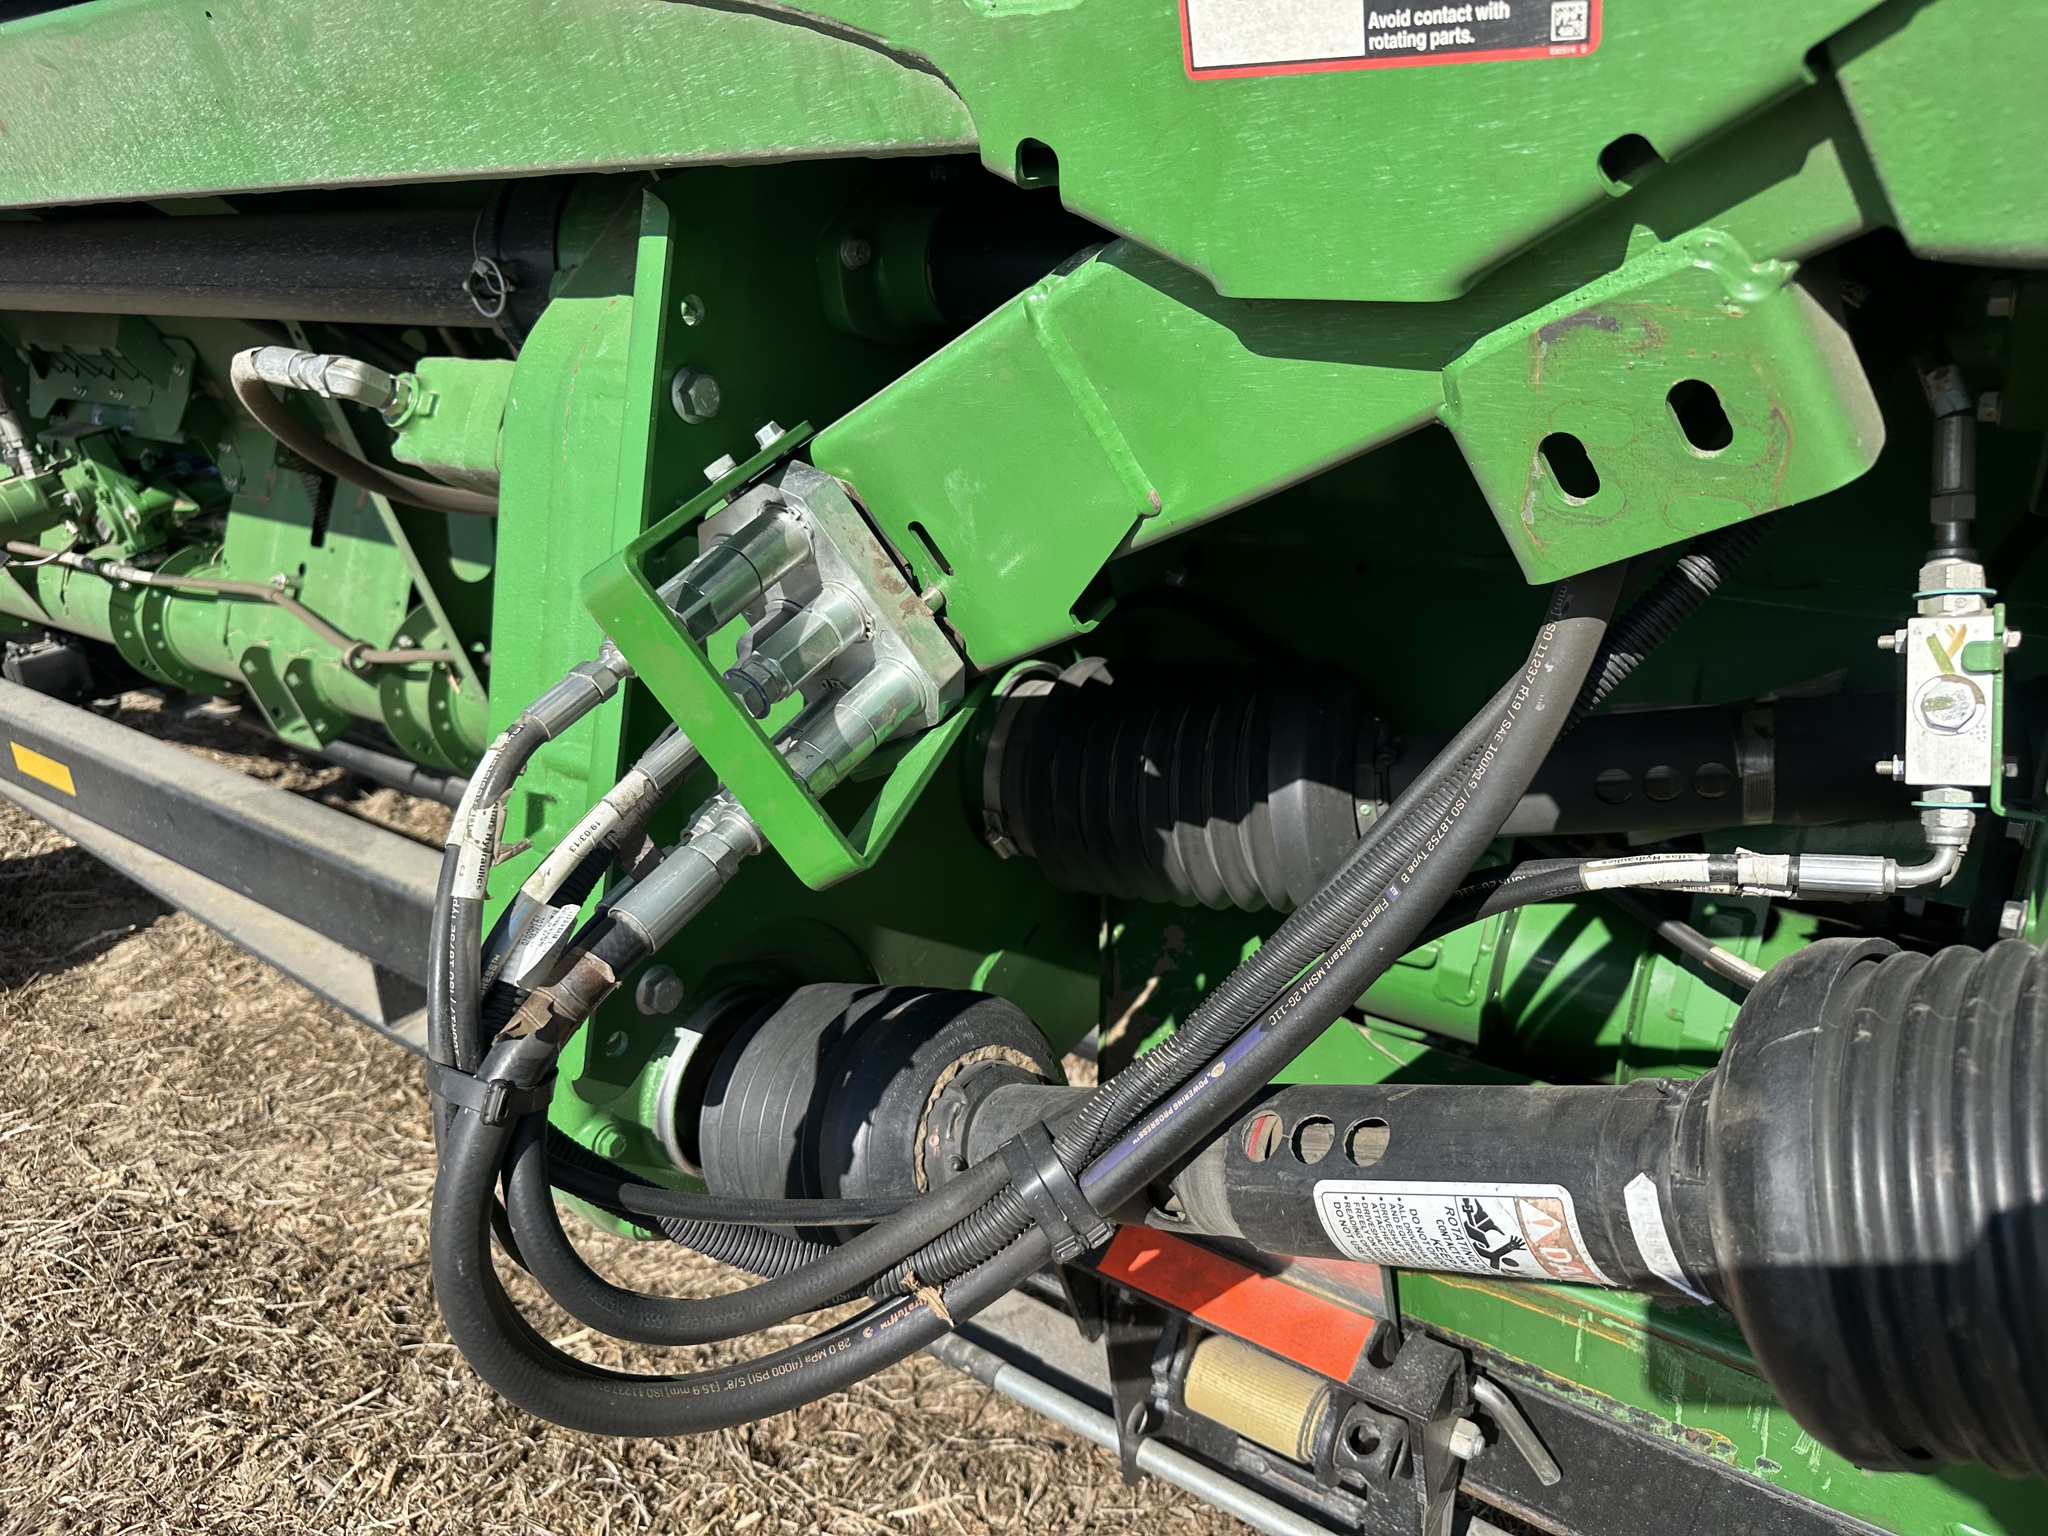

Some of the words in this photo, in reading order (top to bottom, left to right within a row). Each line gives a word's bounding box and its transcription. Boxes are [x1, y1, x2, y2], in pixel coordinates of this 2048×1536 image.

[1368, 8, 1411, 29] Avoid
[1413, 4, 1473, 26] contact
[1475, 1, 1511, 20] with
[1368, 30, 1427, 51] rotating
[1429, 26, 1476, 50] parts.
[1525, 643, 1548, 685] 11237
[1511, 684, 1530, 711] R19
[1507, 709, 1516, 720] /
[1494, 719, 1512, 744] SAE
[1468, 743, 1499, 790] 100R19
[1451, 796, 1468, 817] ISO
[1463, 788, 1471, 799] /
[568, 820, 601, 853] 19/03/13
[1425, 815, 1454, 852] 18752
[475, 832, 495, 891] Hydraulics
[1407, 850, 1430, 874] Type
[1601, 855, 1662, 865] Hydraulics
[1400, 872, 1411, 884] B
[450, 896, 460, 919] Typ
[1361, 898, 1390, 928] Flame
[1324, 926, 1365, 970] Resistant
[1299, 966, 1327, 994] MSHA
[1268, 990, 1302, 1026] 2G-11C
[1173, 1076, 1210, 1111] POWERING
[1132, 1108, 1175, 1145] PROGRESS™
[1333, 1201, 1344, 1218] DO
[1409, 1208, 1421, 1225] DO
[1338, 1219, 1355, 1239] NOT
[1344, 1202, 1364, 1239] READING
[1359, 1239, 1379, 1258] OPERA
[1353, 1202, 1371, 1235] FREELY
[1366, 1236, 1378, 1247] ON
[1361, 1202, 1389, 1250] DRIVESHAFT
[1371, 1202, 1395, 1247] ATTACHED
[1389, 1246, 1401, 1255] AT
[1379, 1203, 1407, 1252] DRIVESHAFT
[1389, 1203, 1401, 1223] AND
[1395, 1225, 1426, 1262] EQUIPMENT
[1397, 1203, 1408, 1221] ALL
[1403, 1222, 1434, 1262] DRIVESHAFT
[1414, 1226, 1432, 1246] NOT
[1436, 1219, 1462, 1256] CONTACT
[1444, 1206, 1480, 1263] ROTATING
[1350, 1240, 1367, 1255] USE
[1426, 1246, 1450, 1267] OPERA
[1430, 1237, 1458, 1265] KEEP
[804, 1349, 827, 1363] MPa
[828, 1338, 852, 1355] 28.0
[748, 1371, 770, 1385] PSI]
[771, 1356, 804, 1377] [4000
[646, 1388, 665, 1398] ISO
[692, 1380, 720, 1396] [15.9
